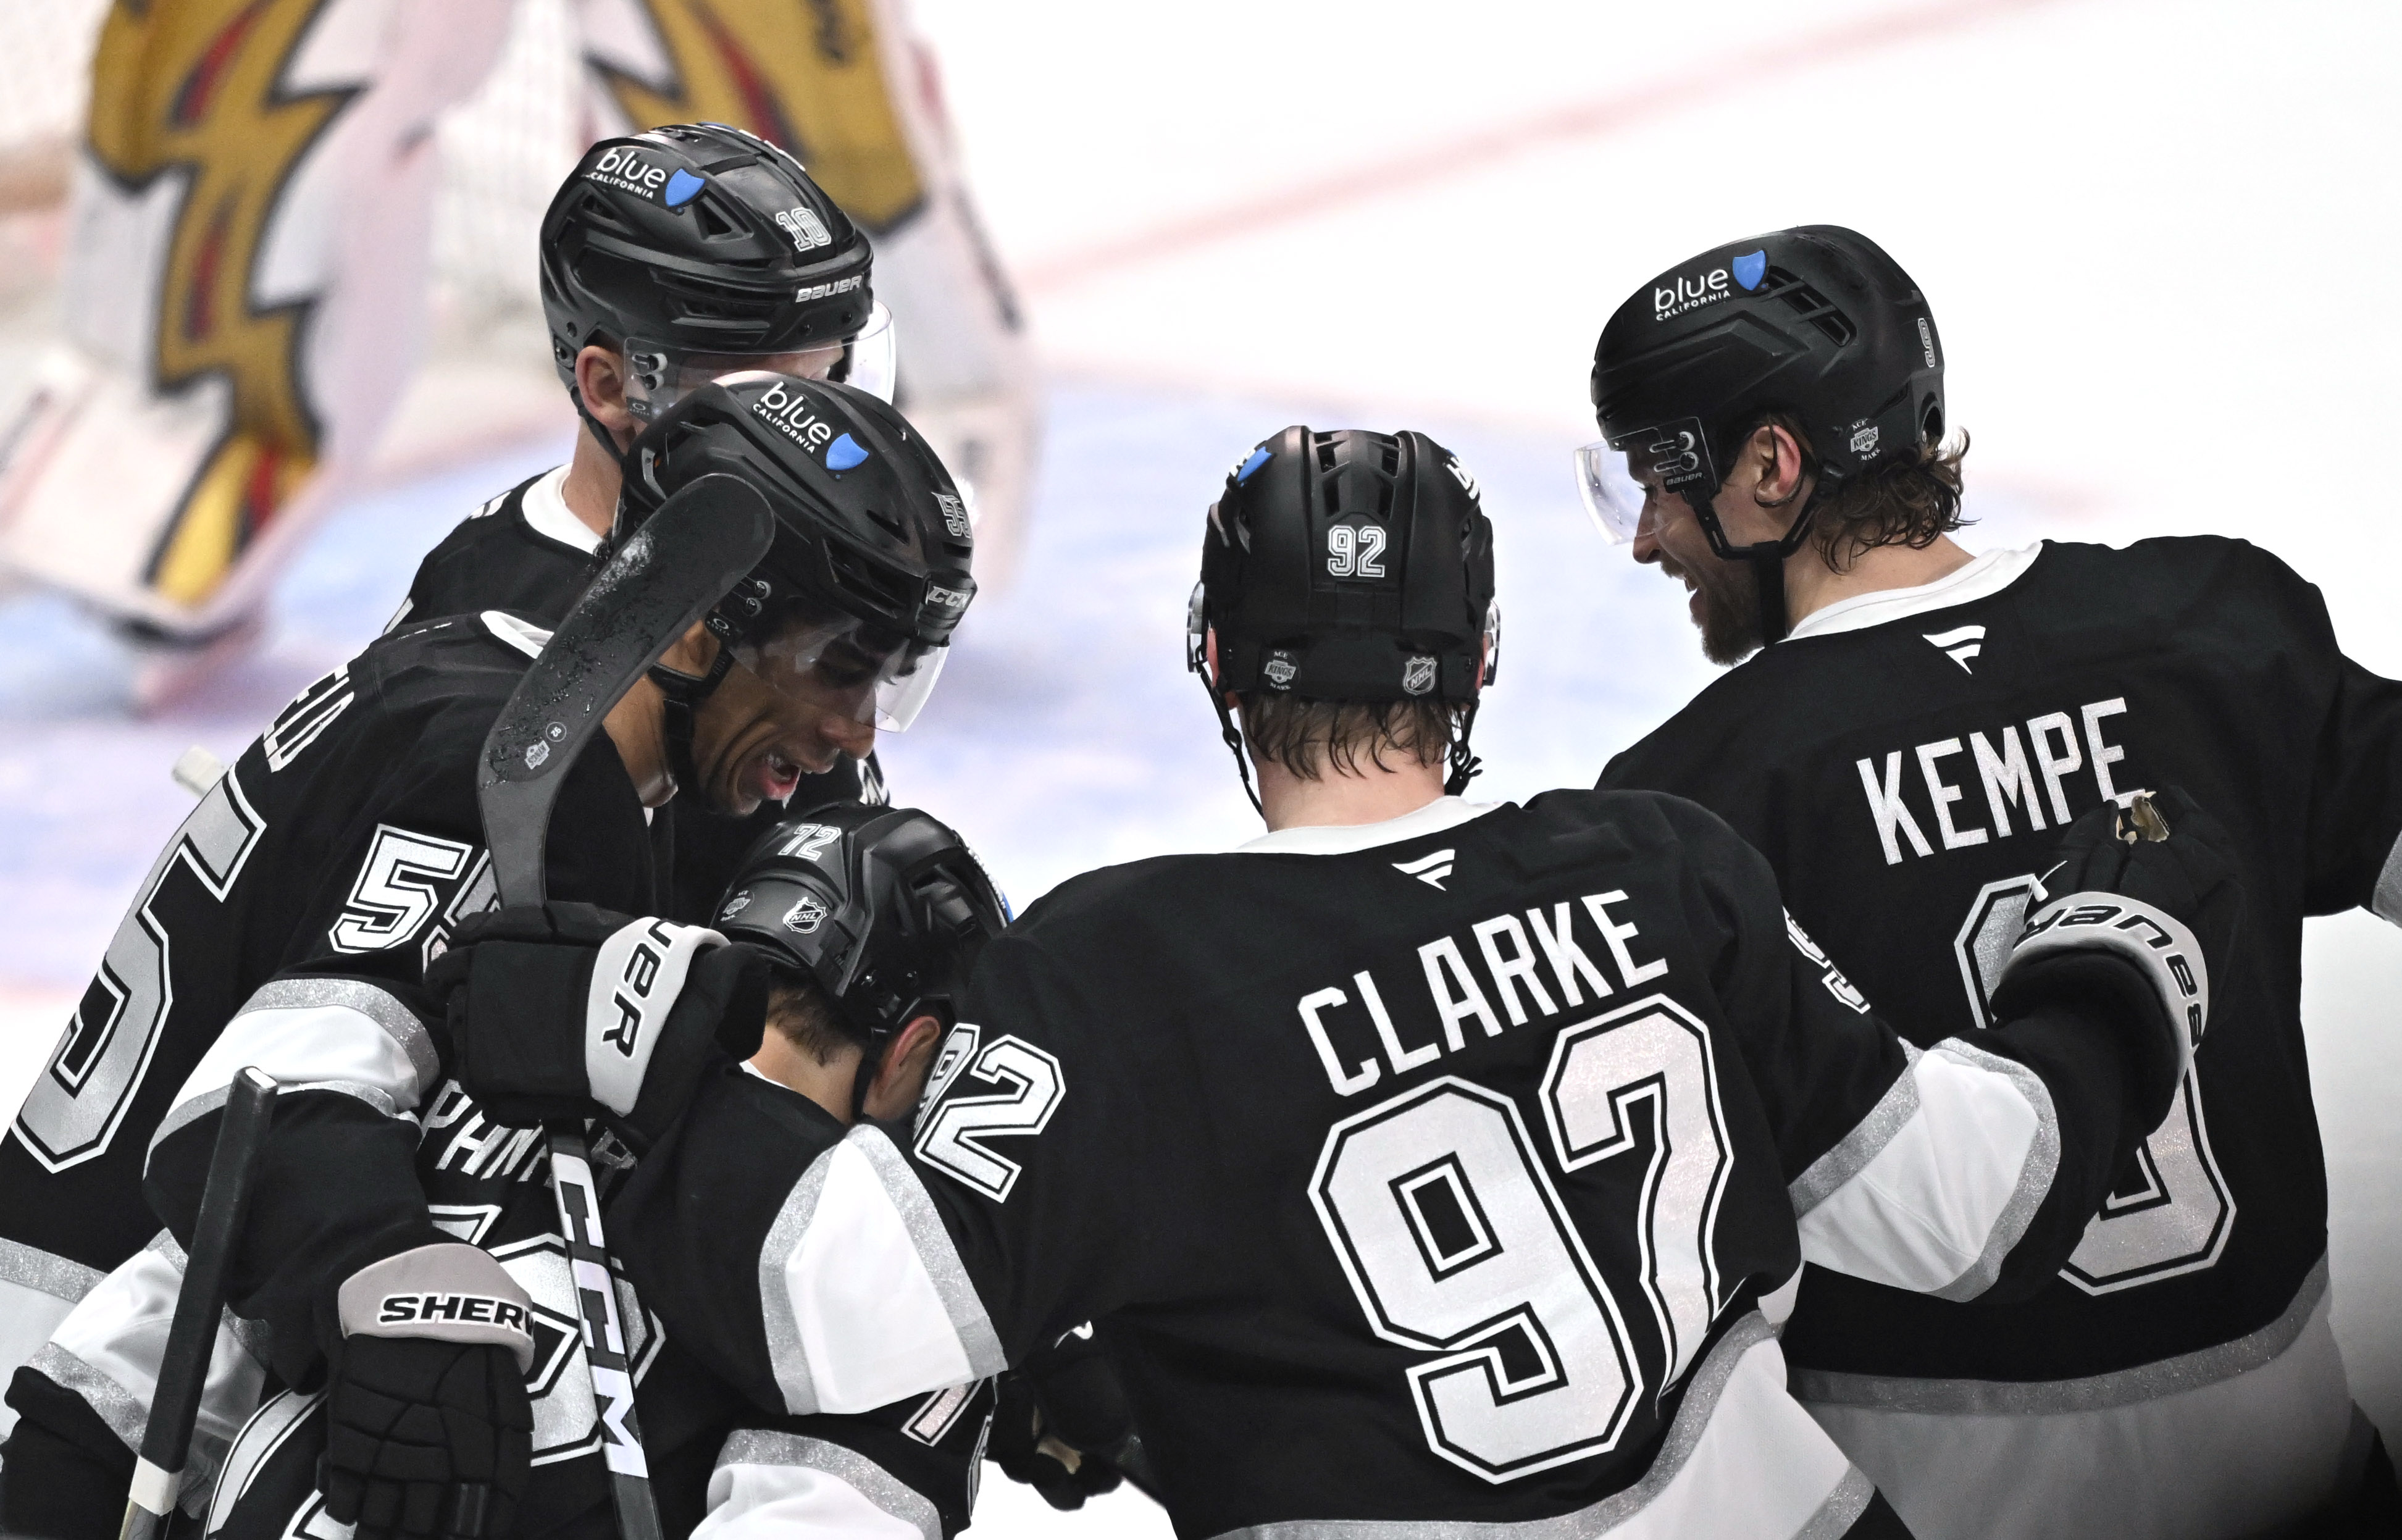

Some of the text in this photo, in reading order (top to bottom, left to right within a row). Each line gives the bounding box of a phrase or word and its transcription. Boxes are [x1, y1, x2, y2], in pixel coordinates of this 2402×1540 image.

[590, 171, 653, 199] CALIFORNIA
[596, 148, 666, 188] blue
[776, 207, 832, 252] 10
[795, 275, 862, 303] BAUER
[1654, 268, 1728, 312] blue
[1655, 289, 1731, 321] CALIFORNIA
[752, 403, 815, 454] CALIFORNIA
[760, 381, 831, 445] blue
[1327, 524, 1386, 578] 92
[1408, 666, 1431, 688] NHL
[1857, 697, 2146, 865] KEMPE
[778, 823, 842, 861] 72
[790, 913, 816, 921] NHL
[1297, 889, 1669, 1097] CLARKE
[913, 1022, 1067, 1204] 92
[551, 1152, 649, 1478] CCM
